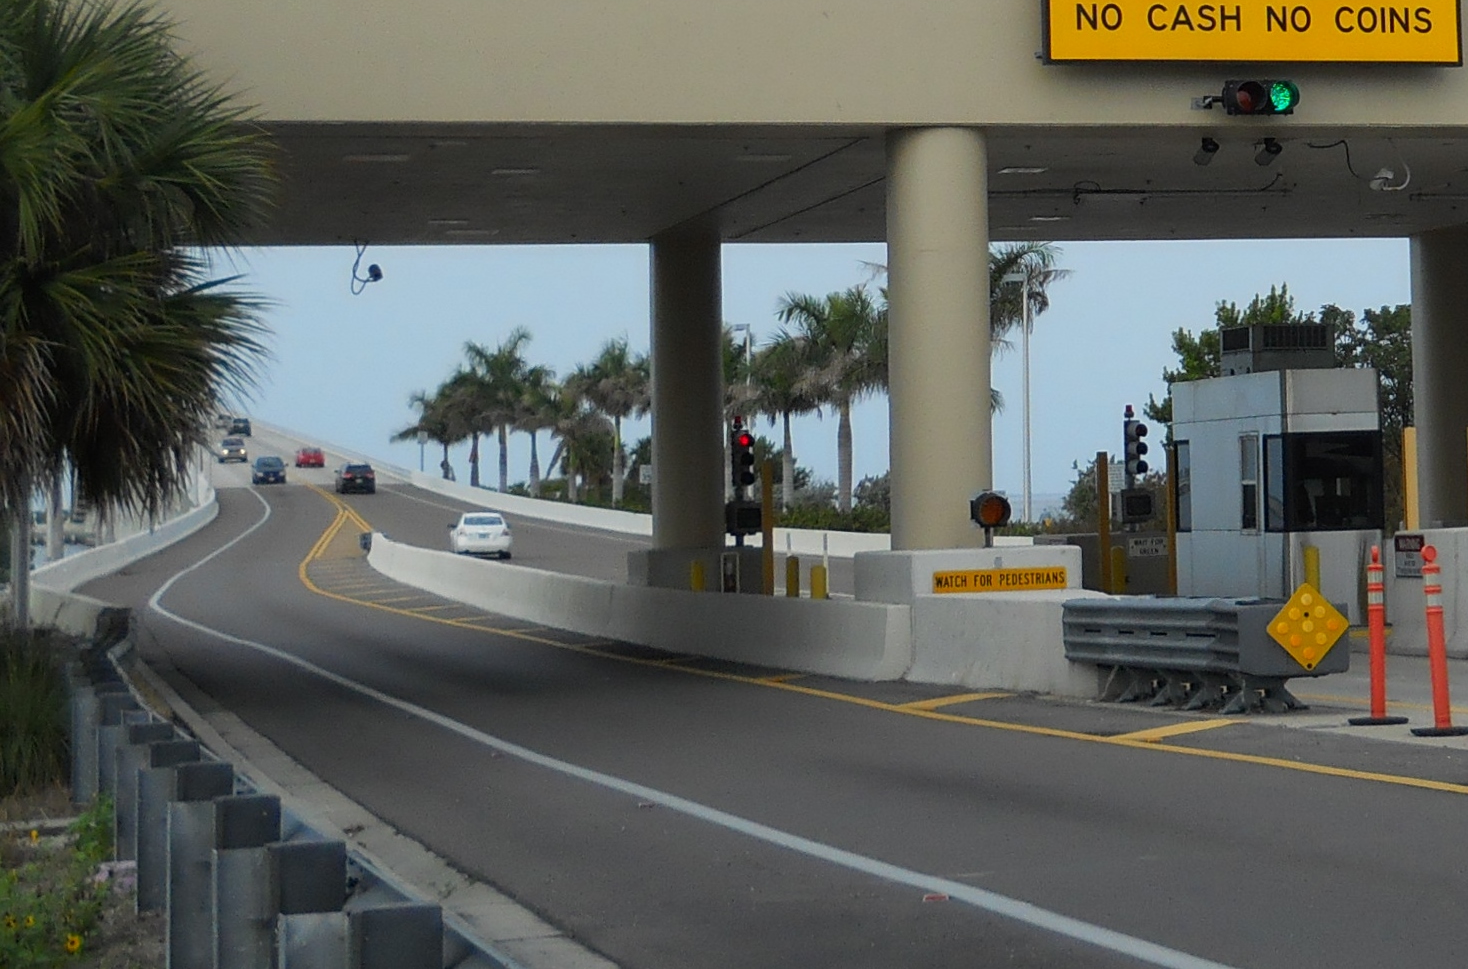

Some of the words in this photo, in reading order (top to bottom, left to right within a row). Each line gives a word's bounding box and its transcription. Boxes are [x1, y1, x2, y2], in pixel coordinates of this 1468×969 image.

[1076, 3, 1123, 30] NO
[1147, 4, 1242, 32] CASH
[1266, 5, 1312, 32] NO
[1335, 6, 1433, 33] COINS
[935, 575, 967, 588] WATCH
[974, 574, 993, 587] FOR
[999, 571, 1065, 586] PEDESTRIANS
